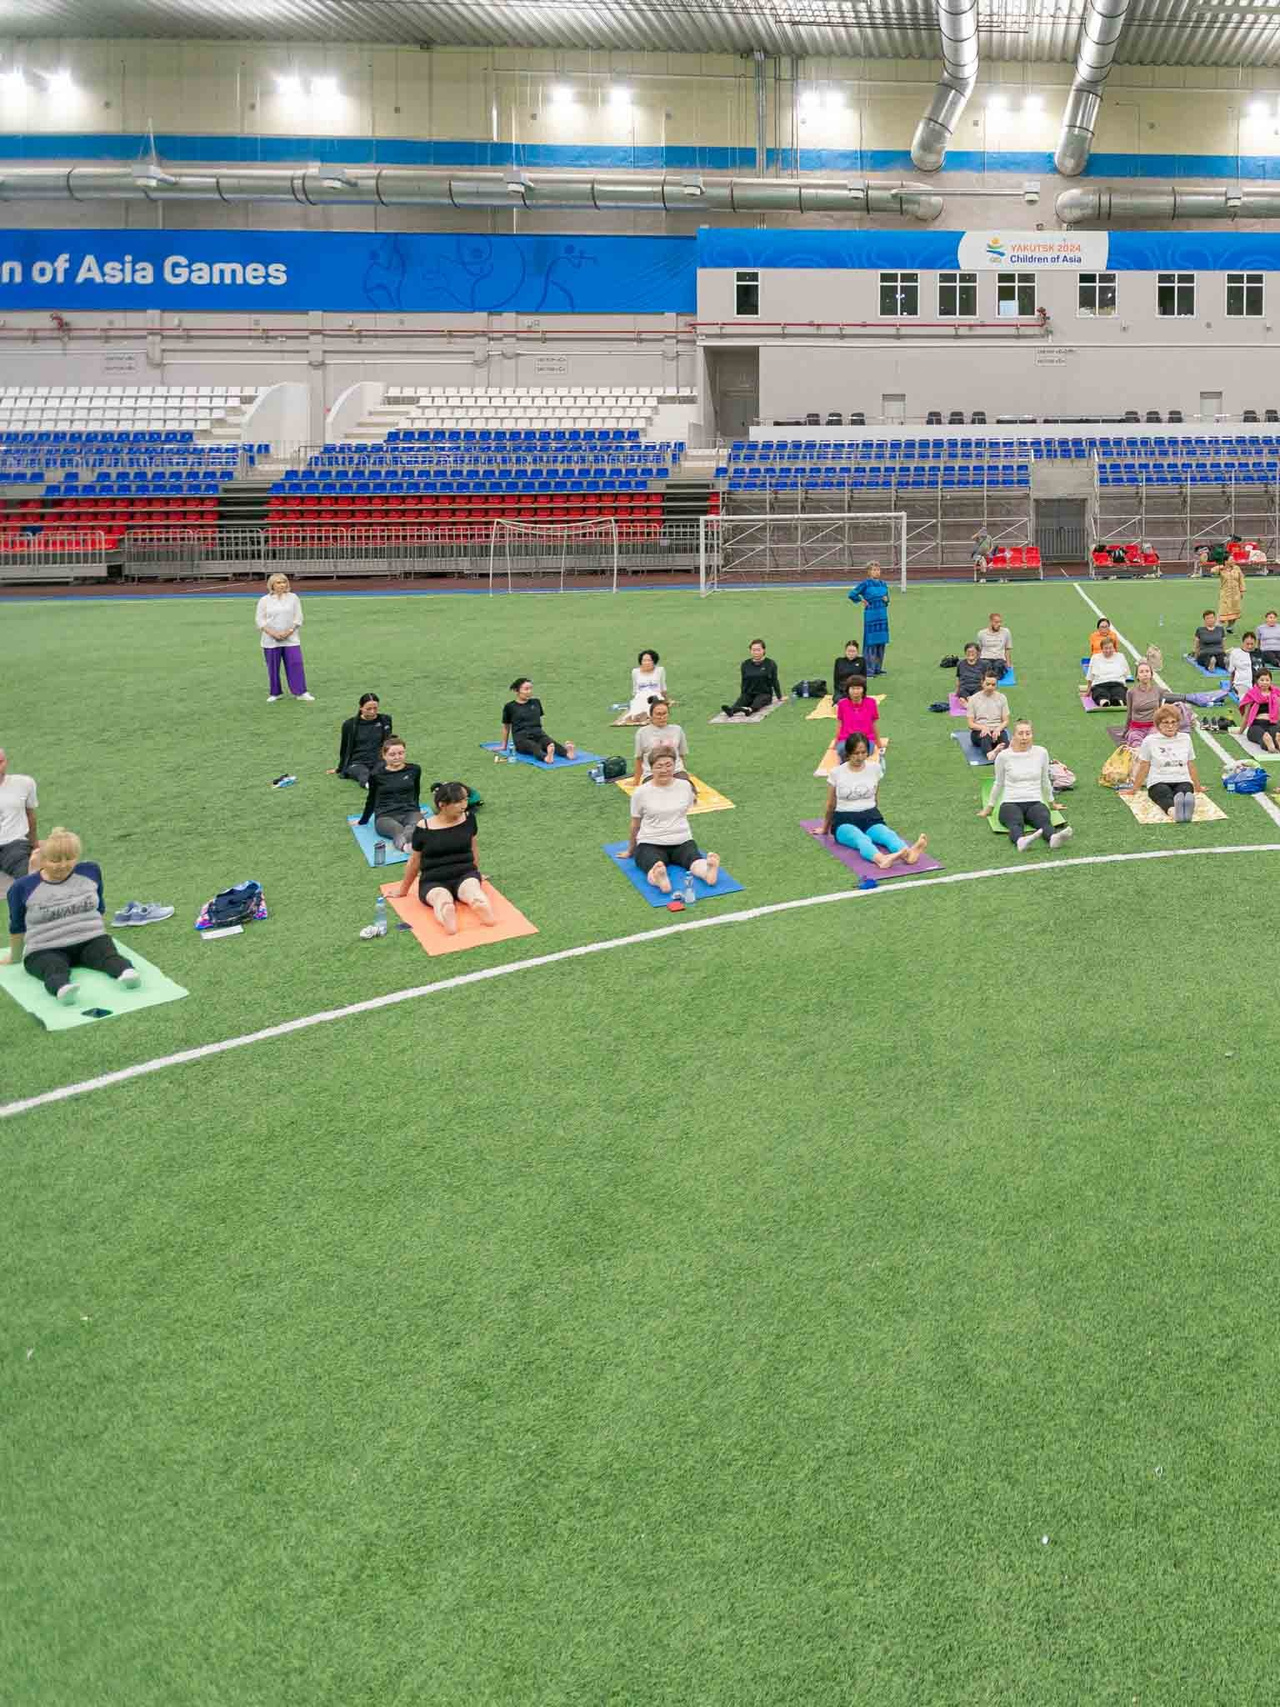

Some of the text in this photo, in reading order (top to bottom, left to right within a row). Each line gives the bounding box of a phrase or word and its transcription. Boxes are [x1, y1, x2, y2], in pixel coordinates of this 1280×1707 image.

[1011, 244, 1081, 253] YAKUTSK 2024
[1010, 255, 1082, 264] Children of Asia
[0, 253, 287, 286] n of Asia Games
